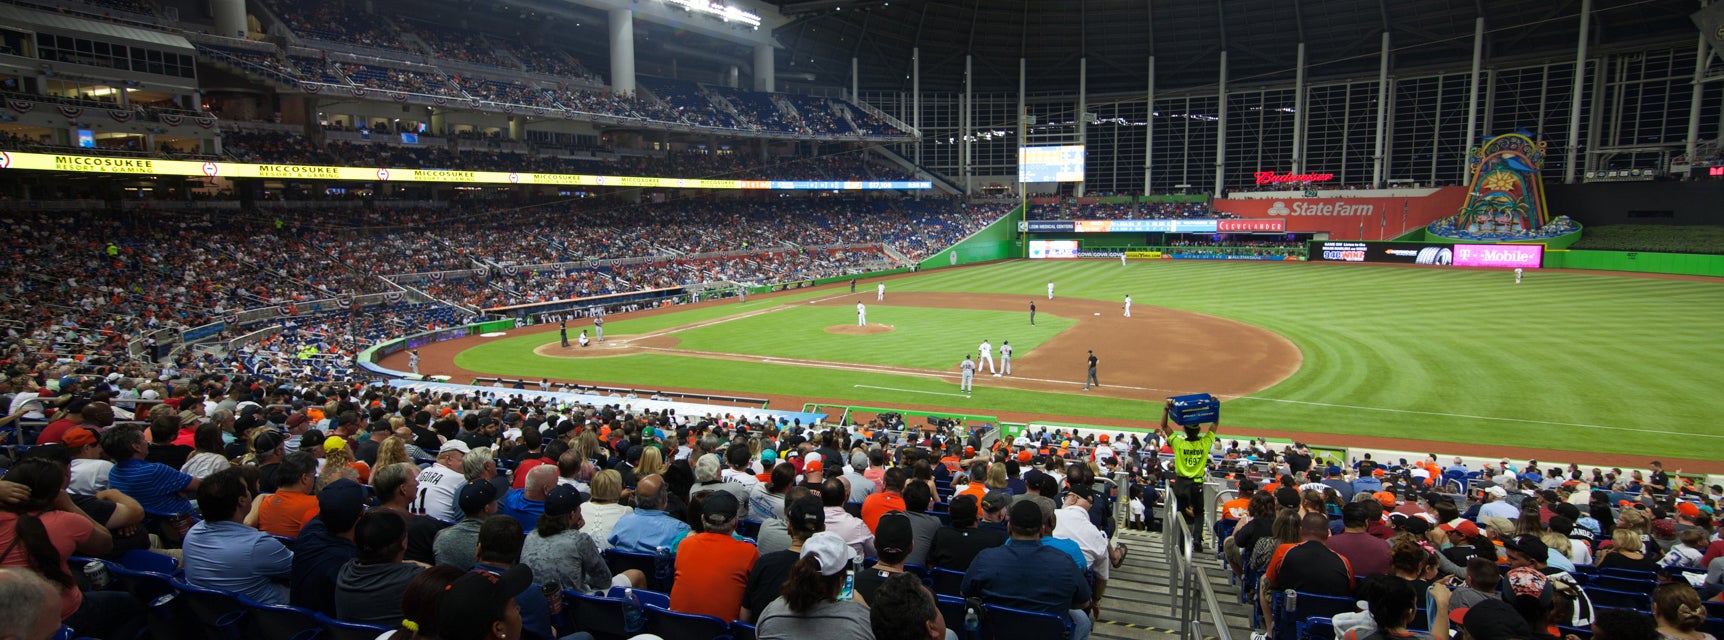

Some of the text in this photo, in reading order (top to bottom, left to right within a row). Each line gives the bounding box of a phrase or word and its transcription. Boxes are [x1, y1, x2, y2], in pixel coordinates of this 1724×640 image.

[55, 156, 152, 167] MICCOSUKEE
[259, 165, 339, 174] MICCOSUKEE
[1253, 171, 1334, 185] Budweiser
[1219, 221, 1282, 231] CLEVELANDER
[420, 471, 443, 485] GURA
